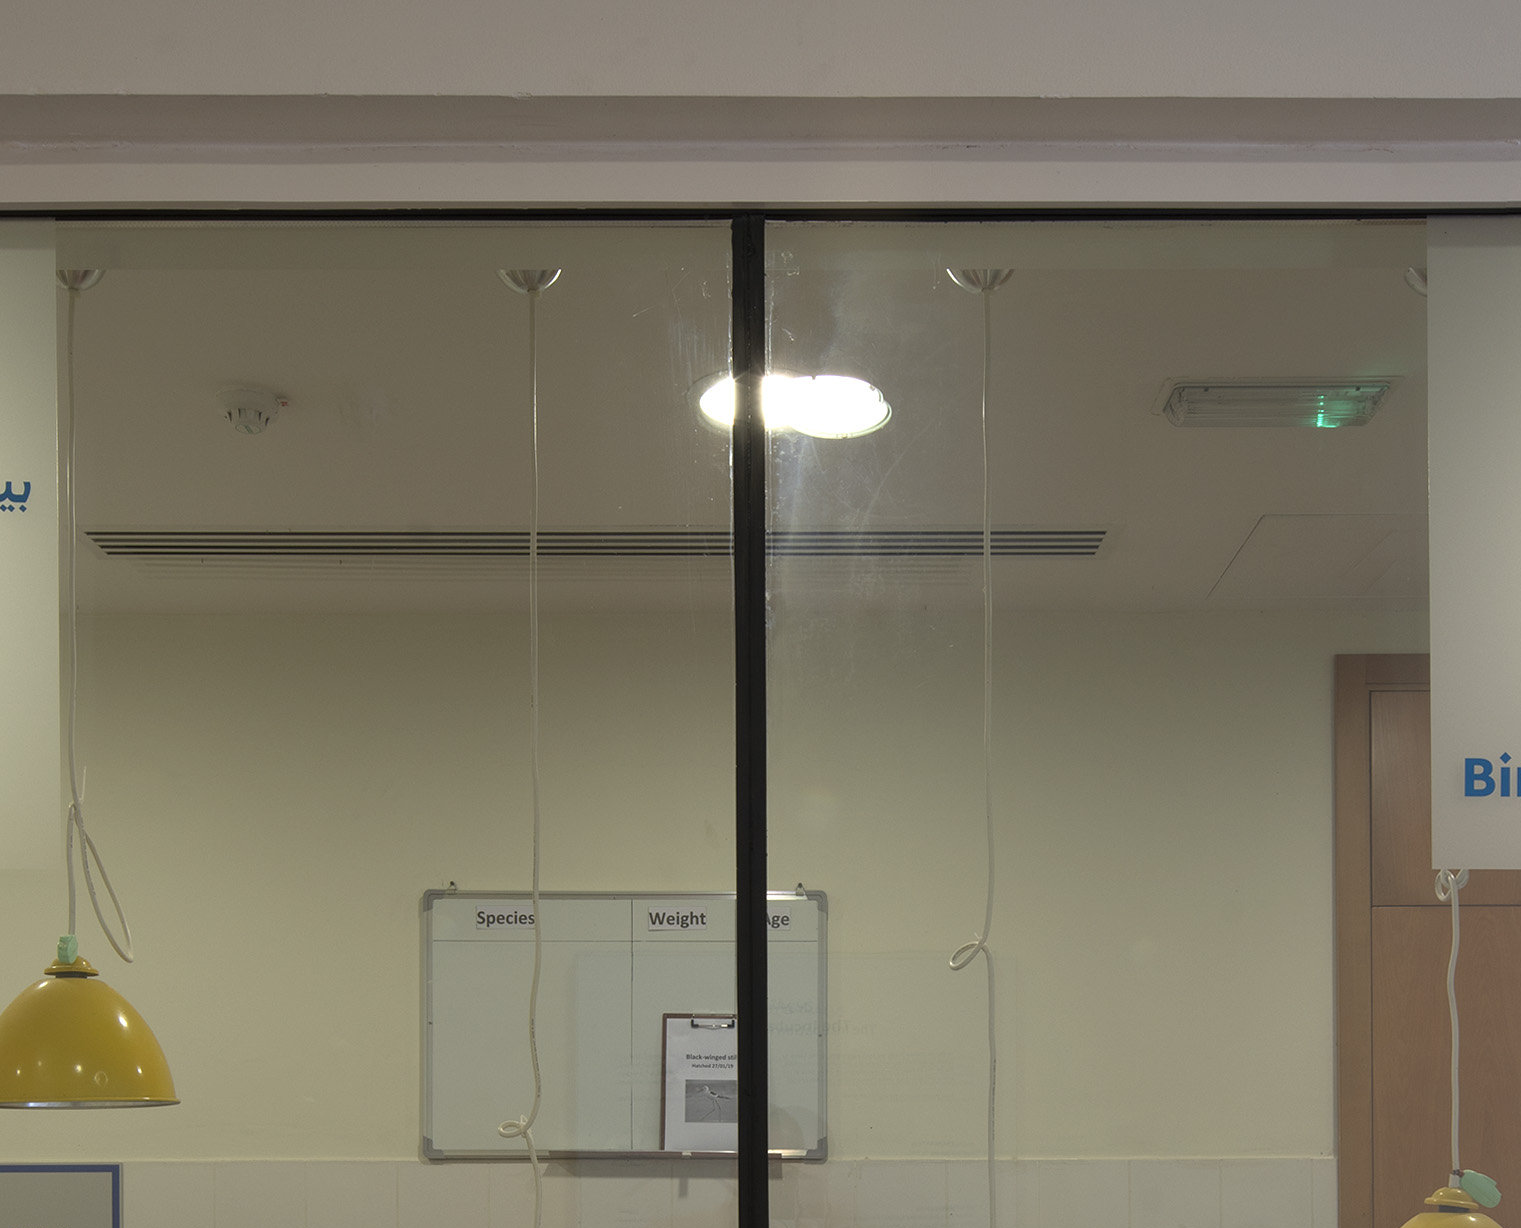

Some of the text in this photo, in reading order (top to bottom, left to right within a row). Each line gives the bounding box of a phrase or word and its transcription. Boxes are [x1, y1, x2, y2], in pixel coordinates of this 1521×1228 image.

[476, 910, 536, 928] Species
[648, 911, 707, 929] Weight
[685, 1053, 727, 1062] Black-winged
